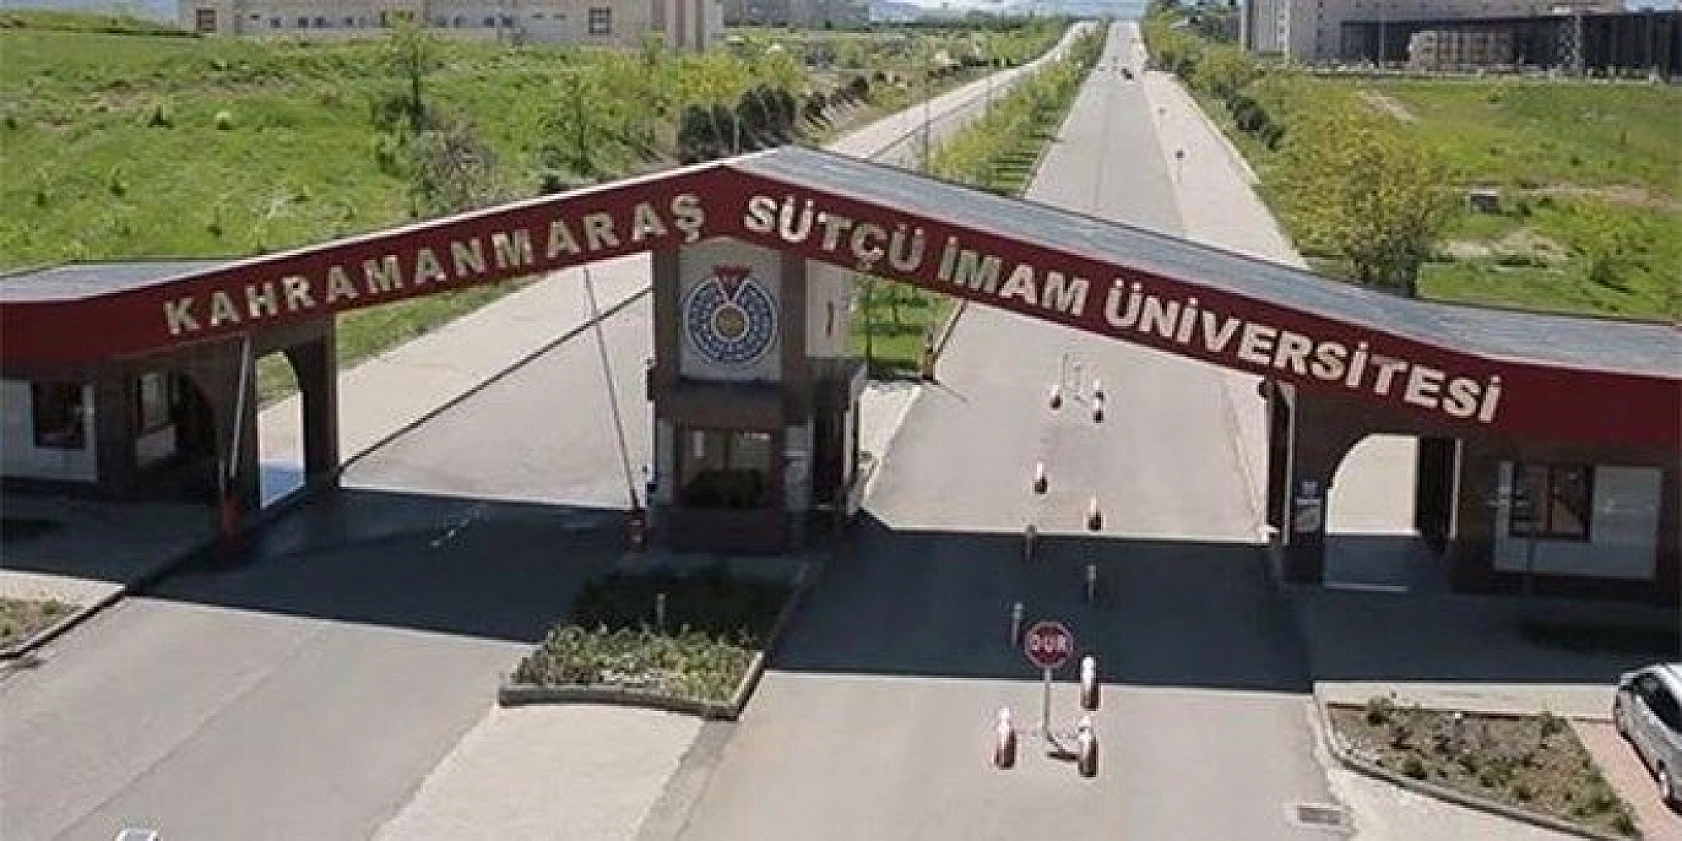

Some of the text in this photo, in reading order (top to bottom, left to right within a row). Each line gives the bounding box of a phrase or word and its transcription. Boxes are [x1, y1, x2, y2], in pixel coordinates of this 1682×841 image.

[164, 193, 706, 335] KAHRAMANMARAŞ
[744, 195, 926, 273] SÜTÇÜ
[937, 236, 1090, 317] İMAM
[1104, 277, 1502, 423] ÜNİVERSİTESİ
[1031, 634, 1066, 652] DUR
